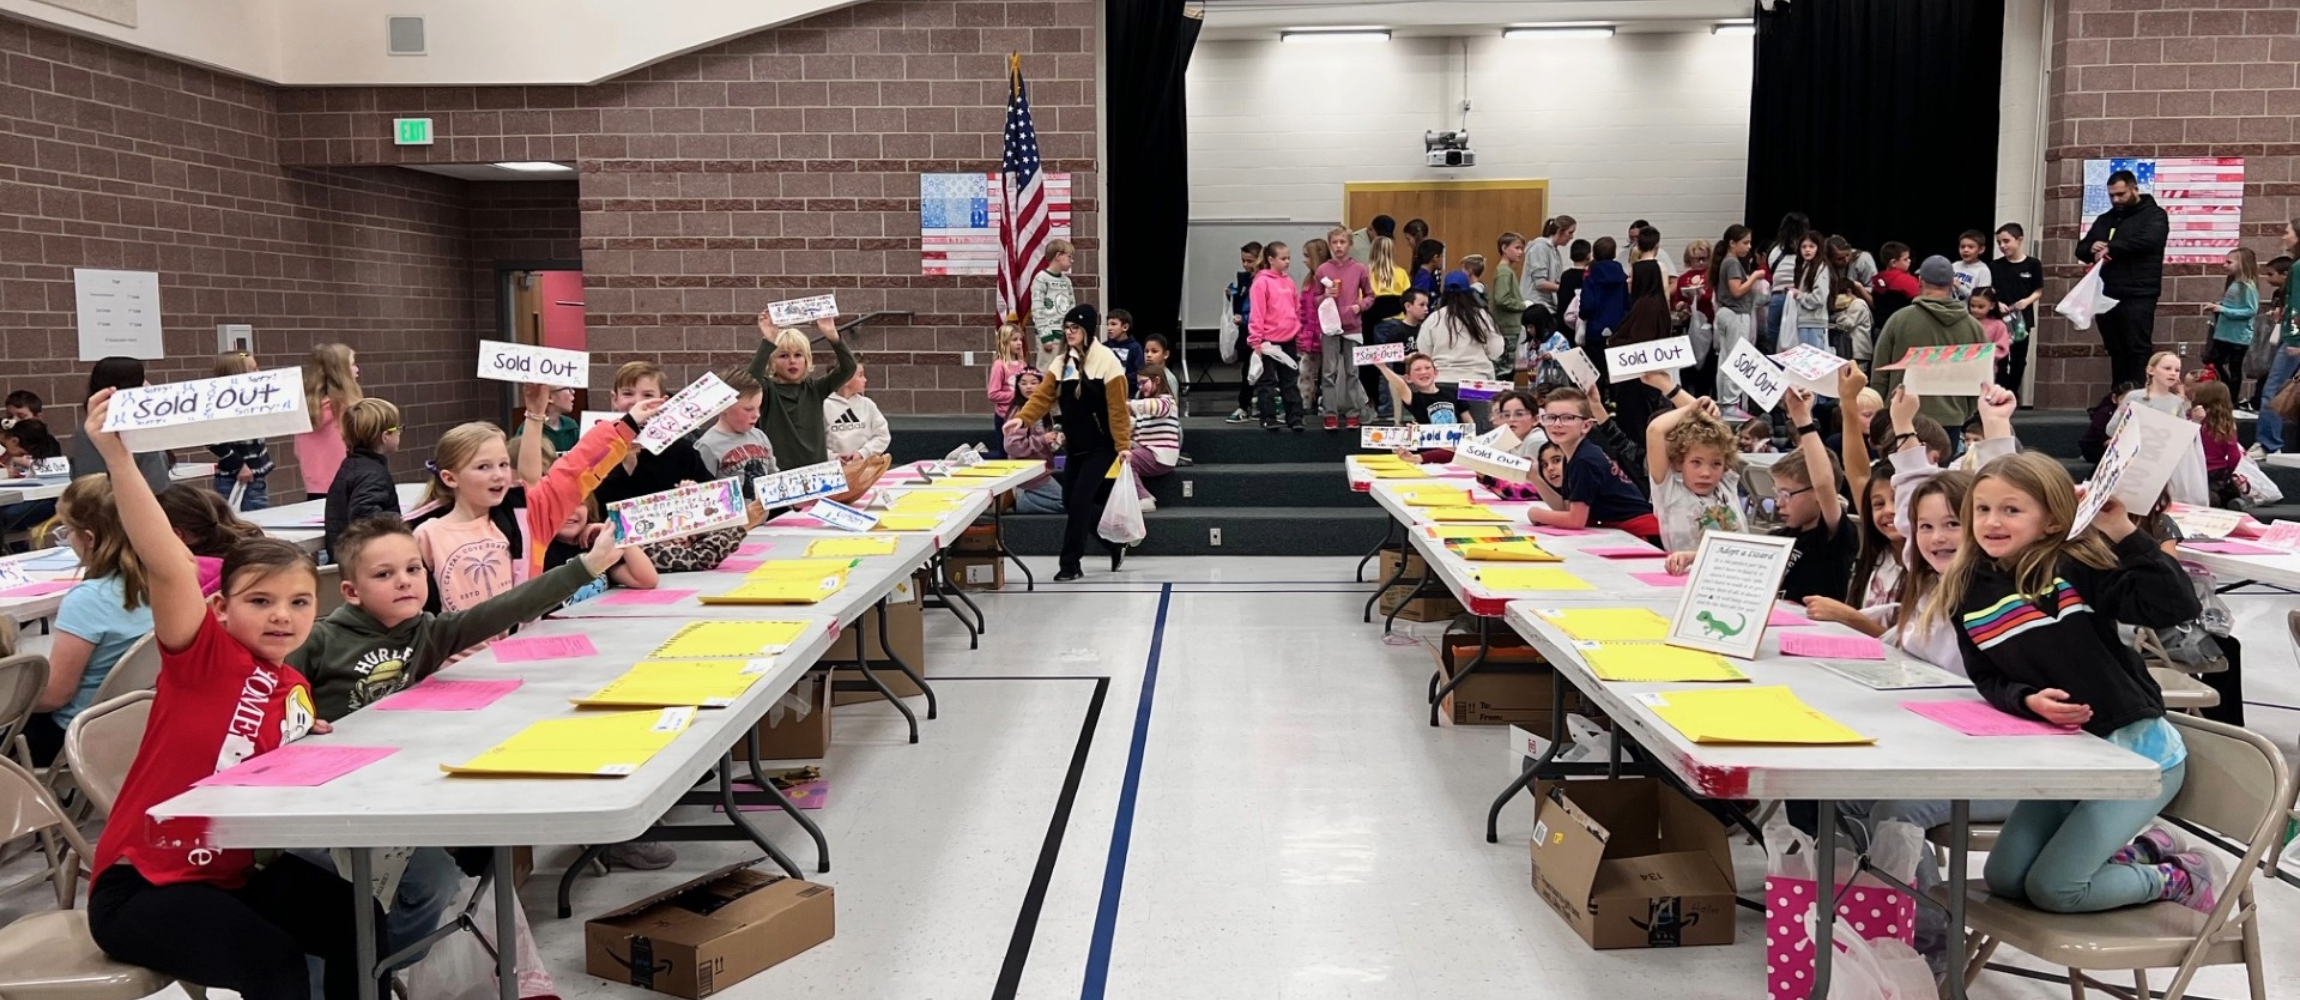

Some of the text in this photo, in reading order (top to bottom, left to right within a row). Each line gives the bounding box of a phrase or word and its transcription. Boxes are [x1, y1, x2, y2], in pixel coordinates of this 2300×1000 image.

[400, 120, 426, 142] EXIT
[494, 353, 577, 377] Sold Out
[1619, 345, 1683, 367] Sold Out
[1734, 353, 1759, 379] Sold
[1754, 372, 1779, 396] Out
[133, 384, 281, 420] Sold Out
[830, 420, 866, 432] adidas
[1420, 430, 1442, 446] Sold
[1466, 445, 1523, 467] Sold Out
[462, 545, 483, 554] COVE
[1716, 547, 1740, 556] Adopt
[1747, 550, 1775, 560] Lizard
